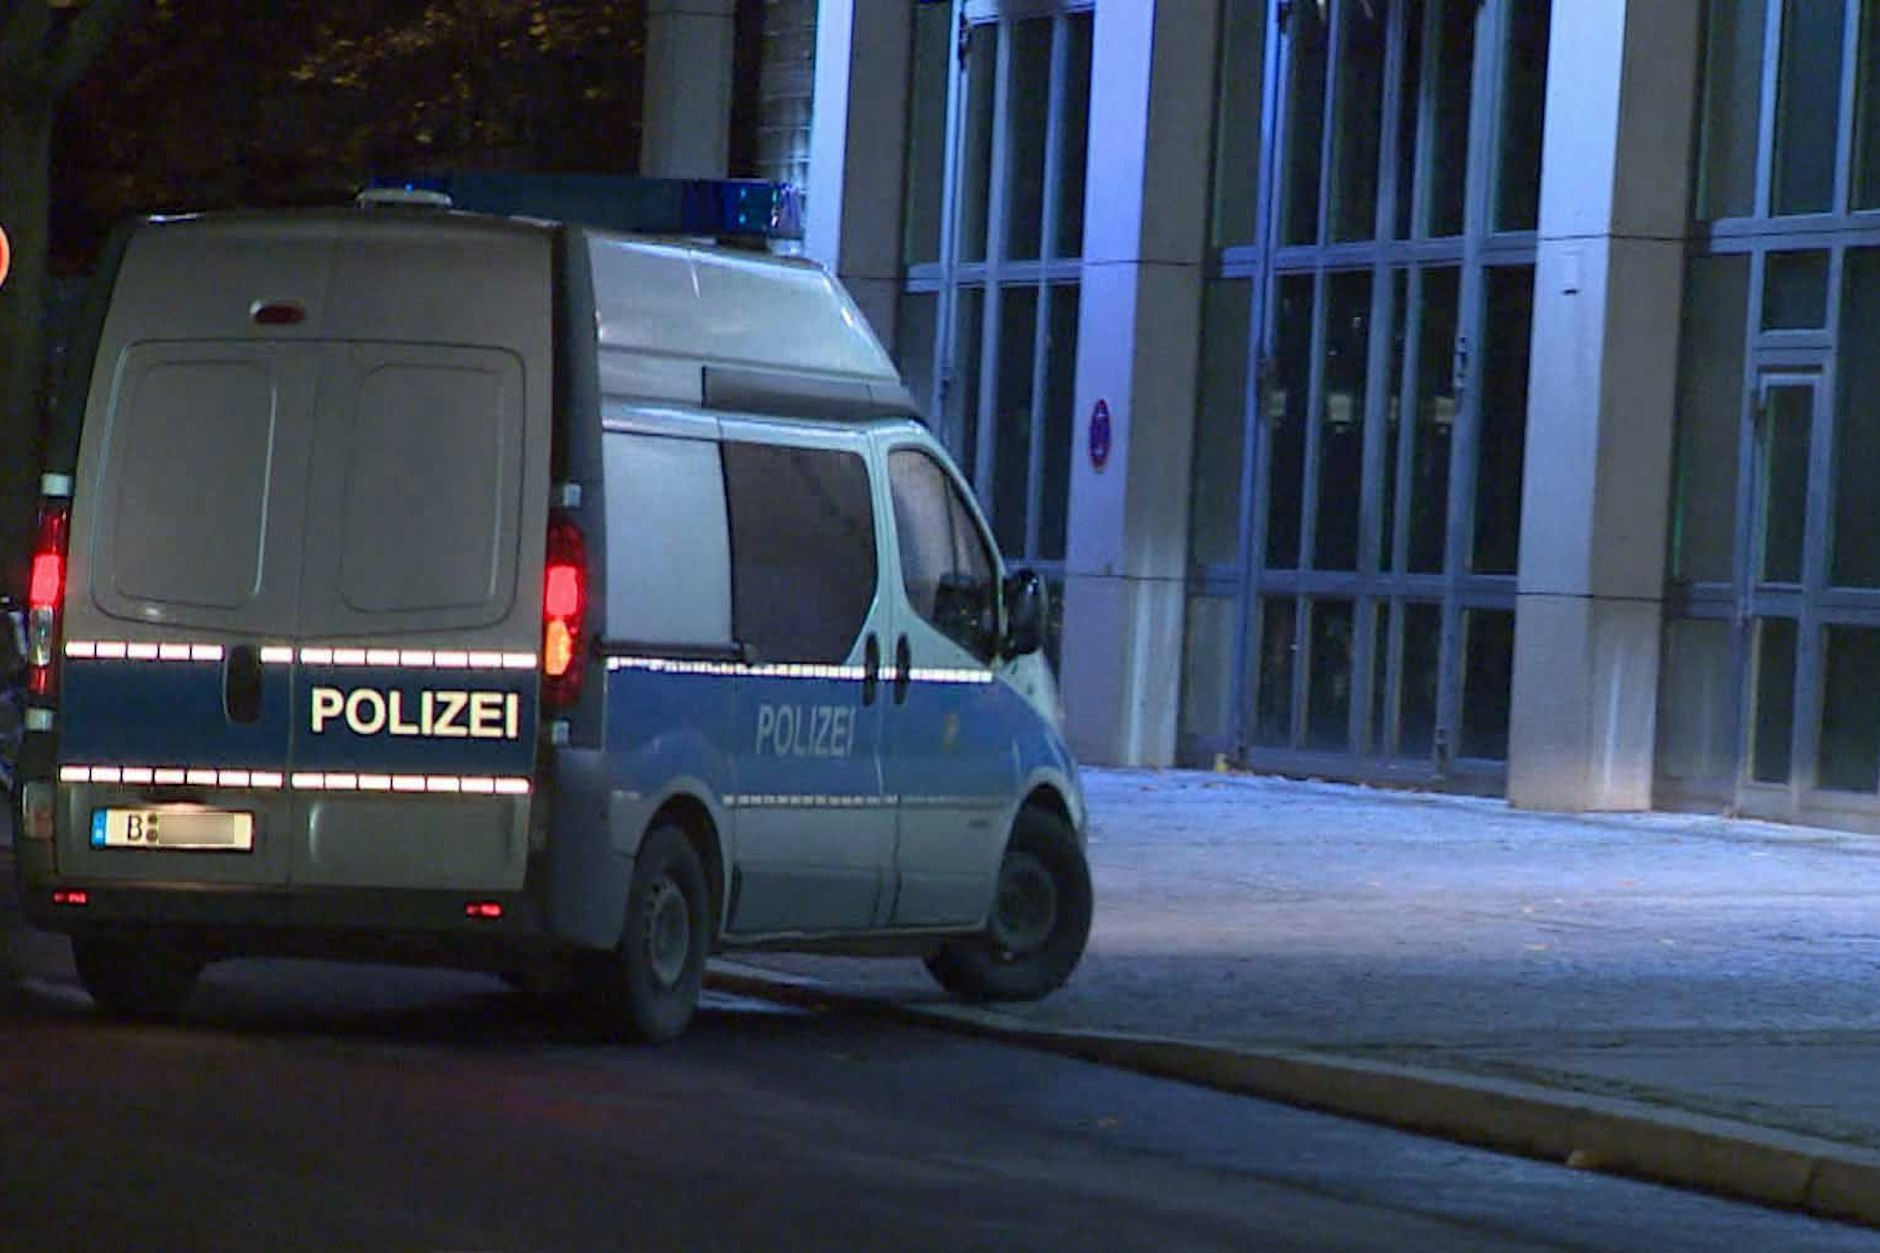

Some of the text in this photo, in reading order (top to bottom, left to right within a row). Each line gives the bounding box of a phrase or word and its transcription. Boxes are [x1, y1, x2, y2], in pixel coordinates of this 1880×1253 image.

[311, 687, 519, 738] POLIZEI
[755, 703, 857, 757] POLIZEI
[127, 814, 143, 841] B
